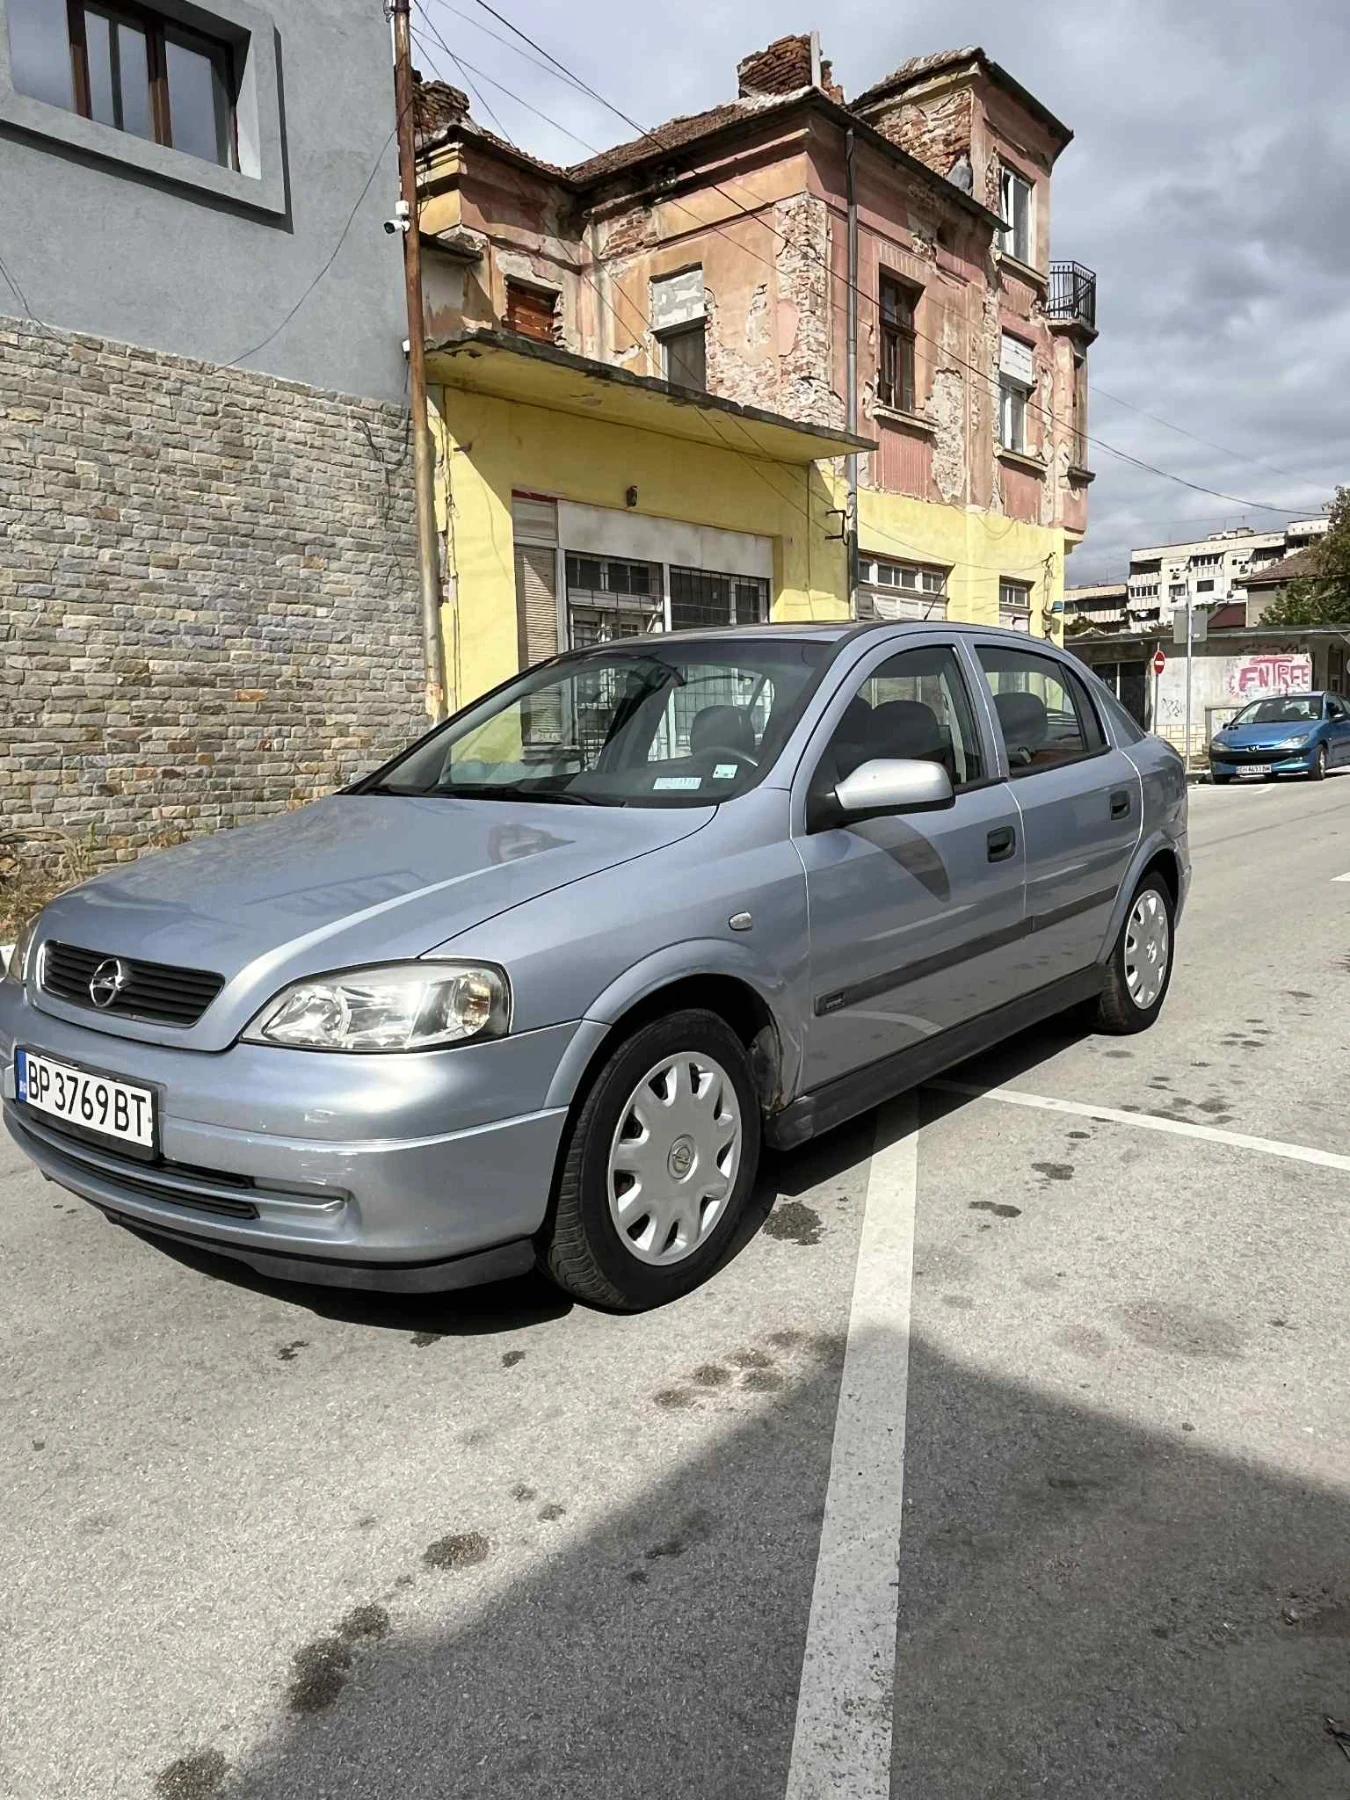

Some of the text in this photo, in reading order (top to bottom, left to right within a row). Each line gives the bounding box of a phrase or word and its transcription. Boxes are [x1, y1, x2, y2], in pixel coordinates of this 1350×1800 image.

[28, 1060, 147, 1137] BP 3769 BT
